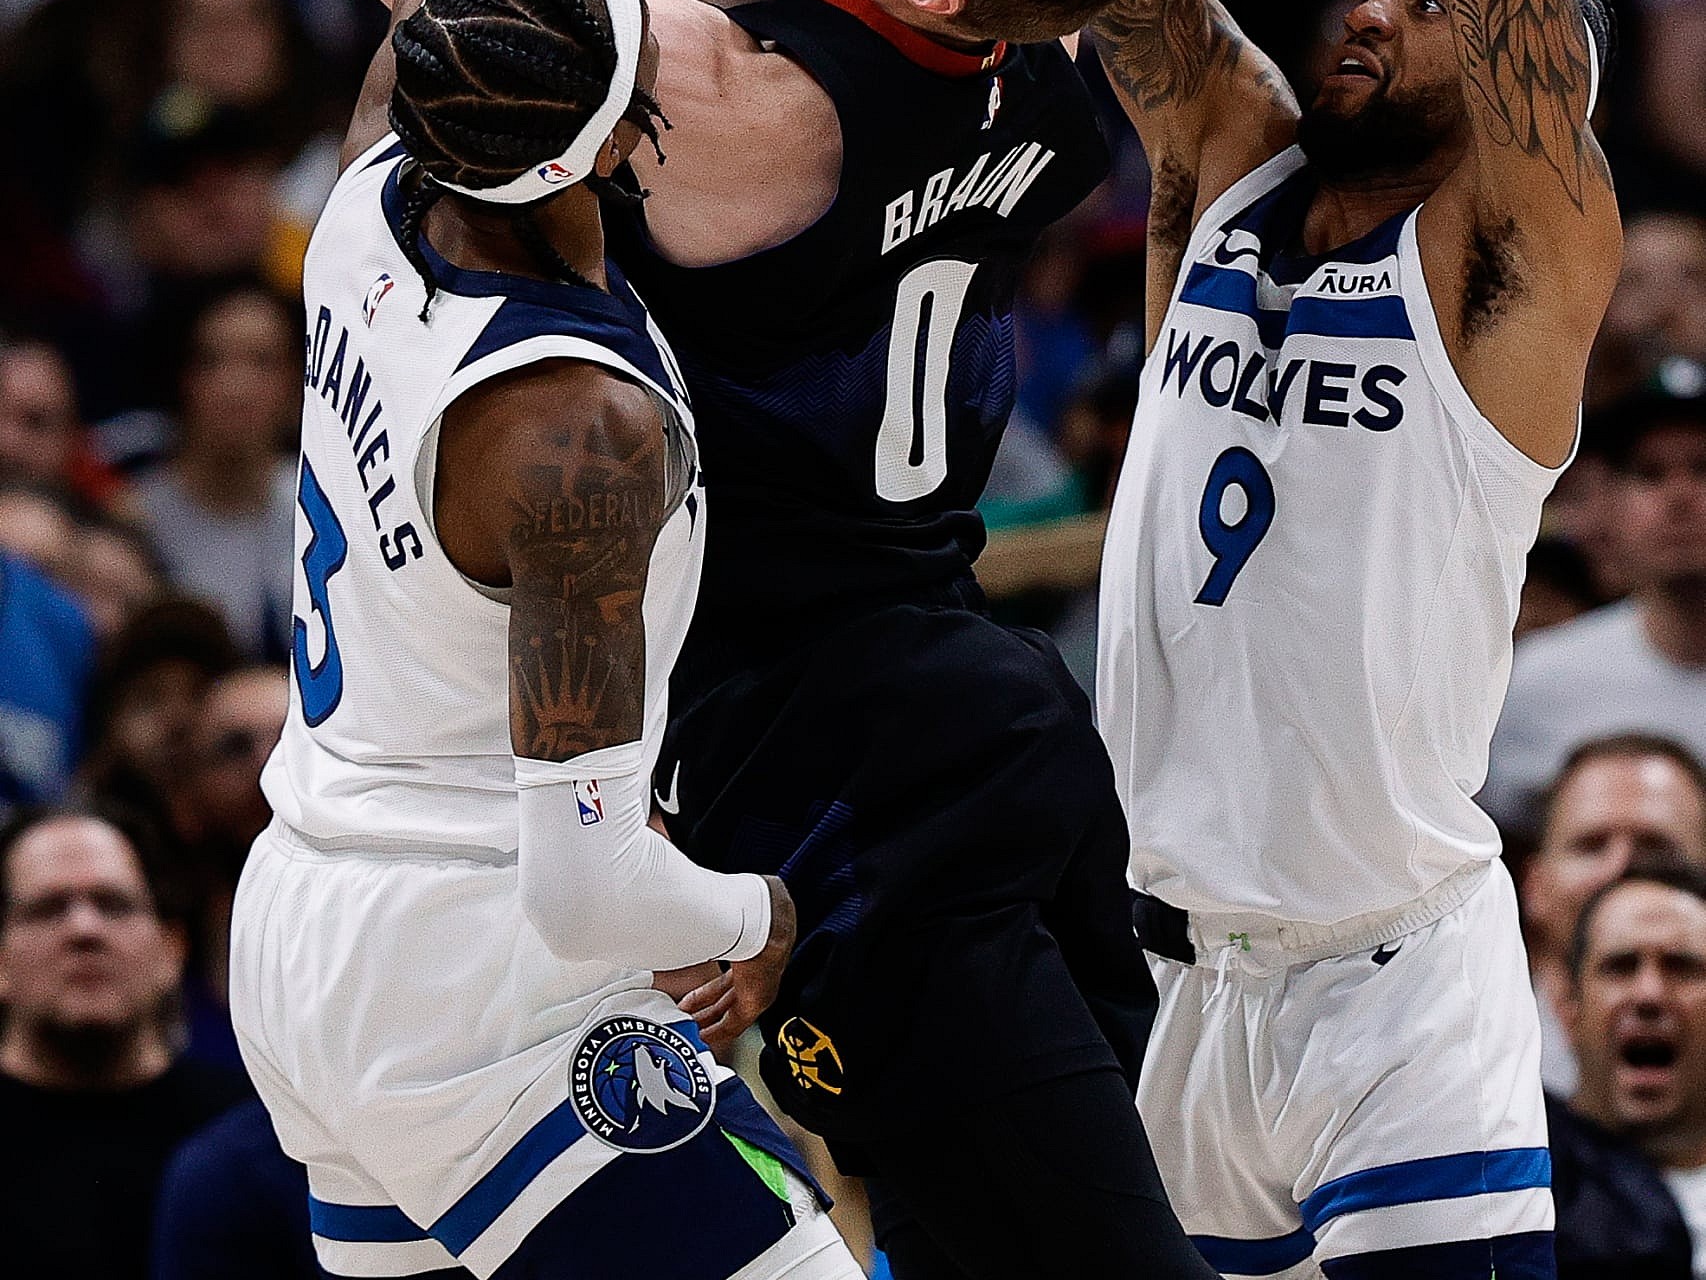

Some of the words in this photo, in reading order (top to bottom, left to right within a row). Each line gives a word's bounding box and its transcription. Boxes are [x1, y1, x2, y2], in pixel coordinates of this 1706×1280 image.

[882, 142, 1055, 256] BRAUN
[874, 259, 979, 502] 0
[1160, 328, 1408, 432] WOLVES
[292, 450, 347, 729] 3
[1193, 446, 1276, 607] 9
[575, 1038, 614, 1137] MINNESOTA
[603, 1020, 709, 1094] TIMBERWOLVES
